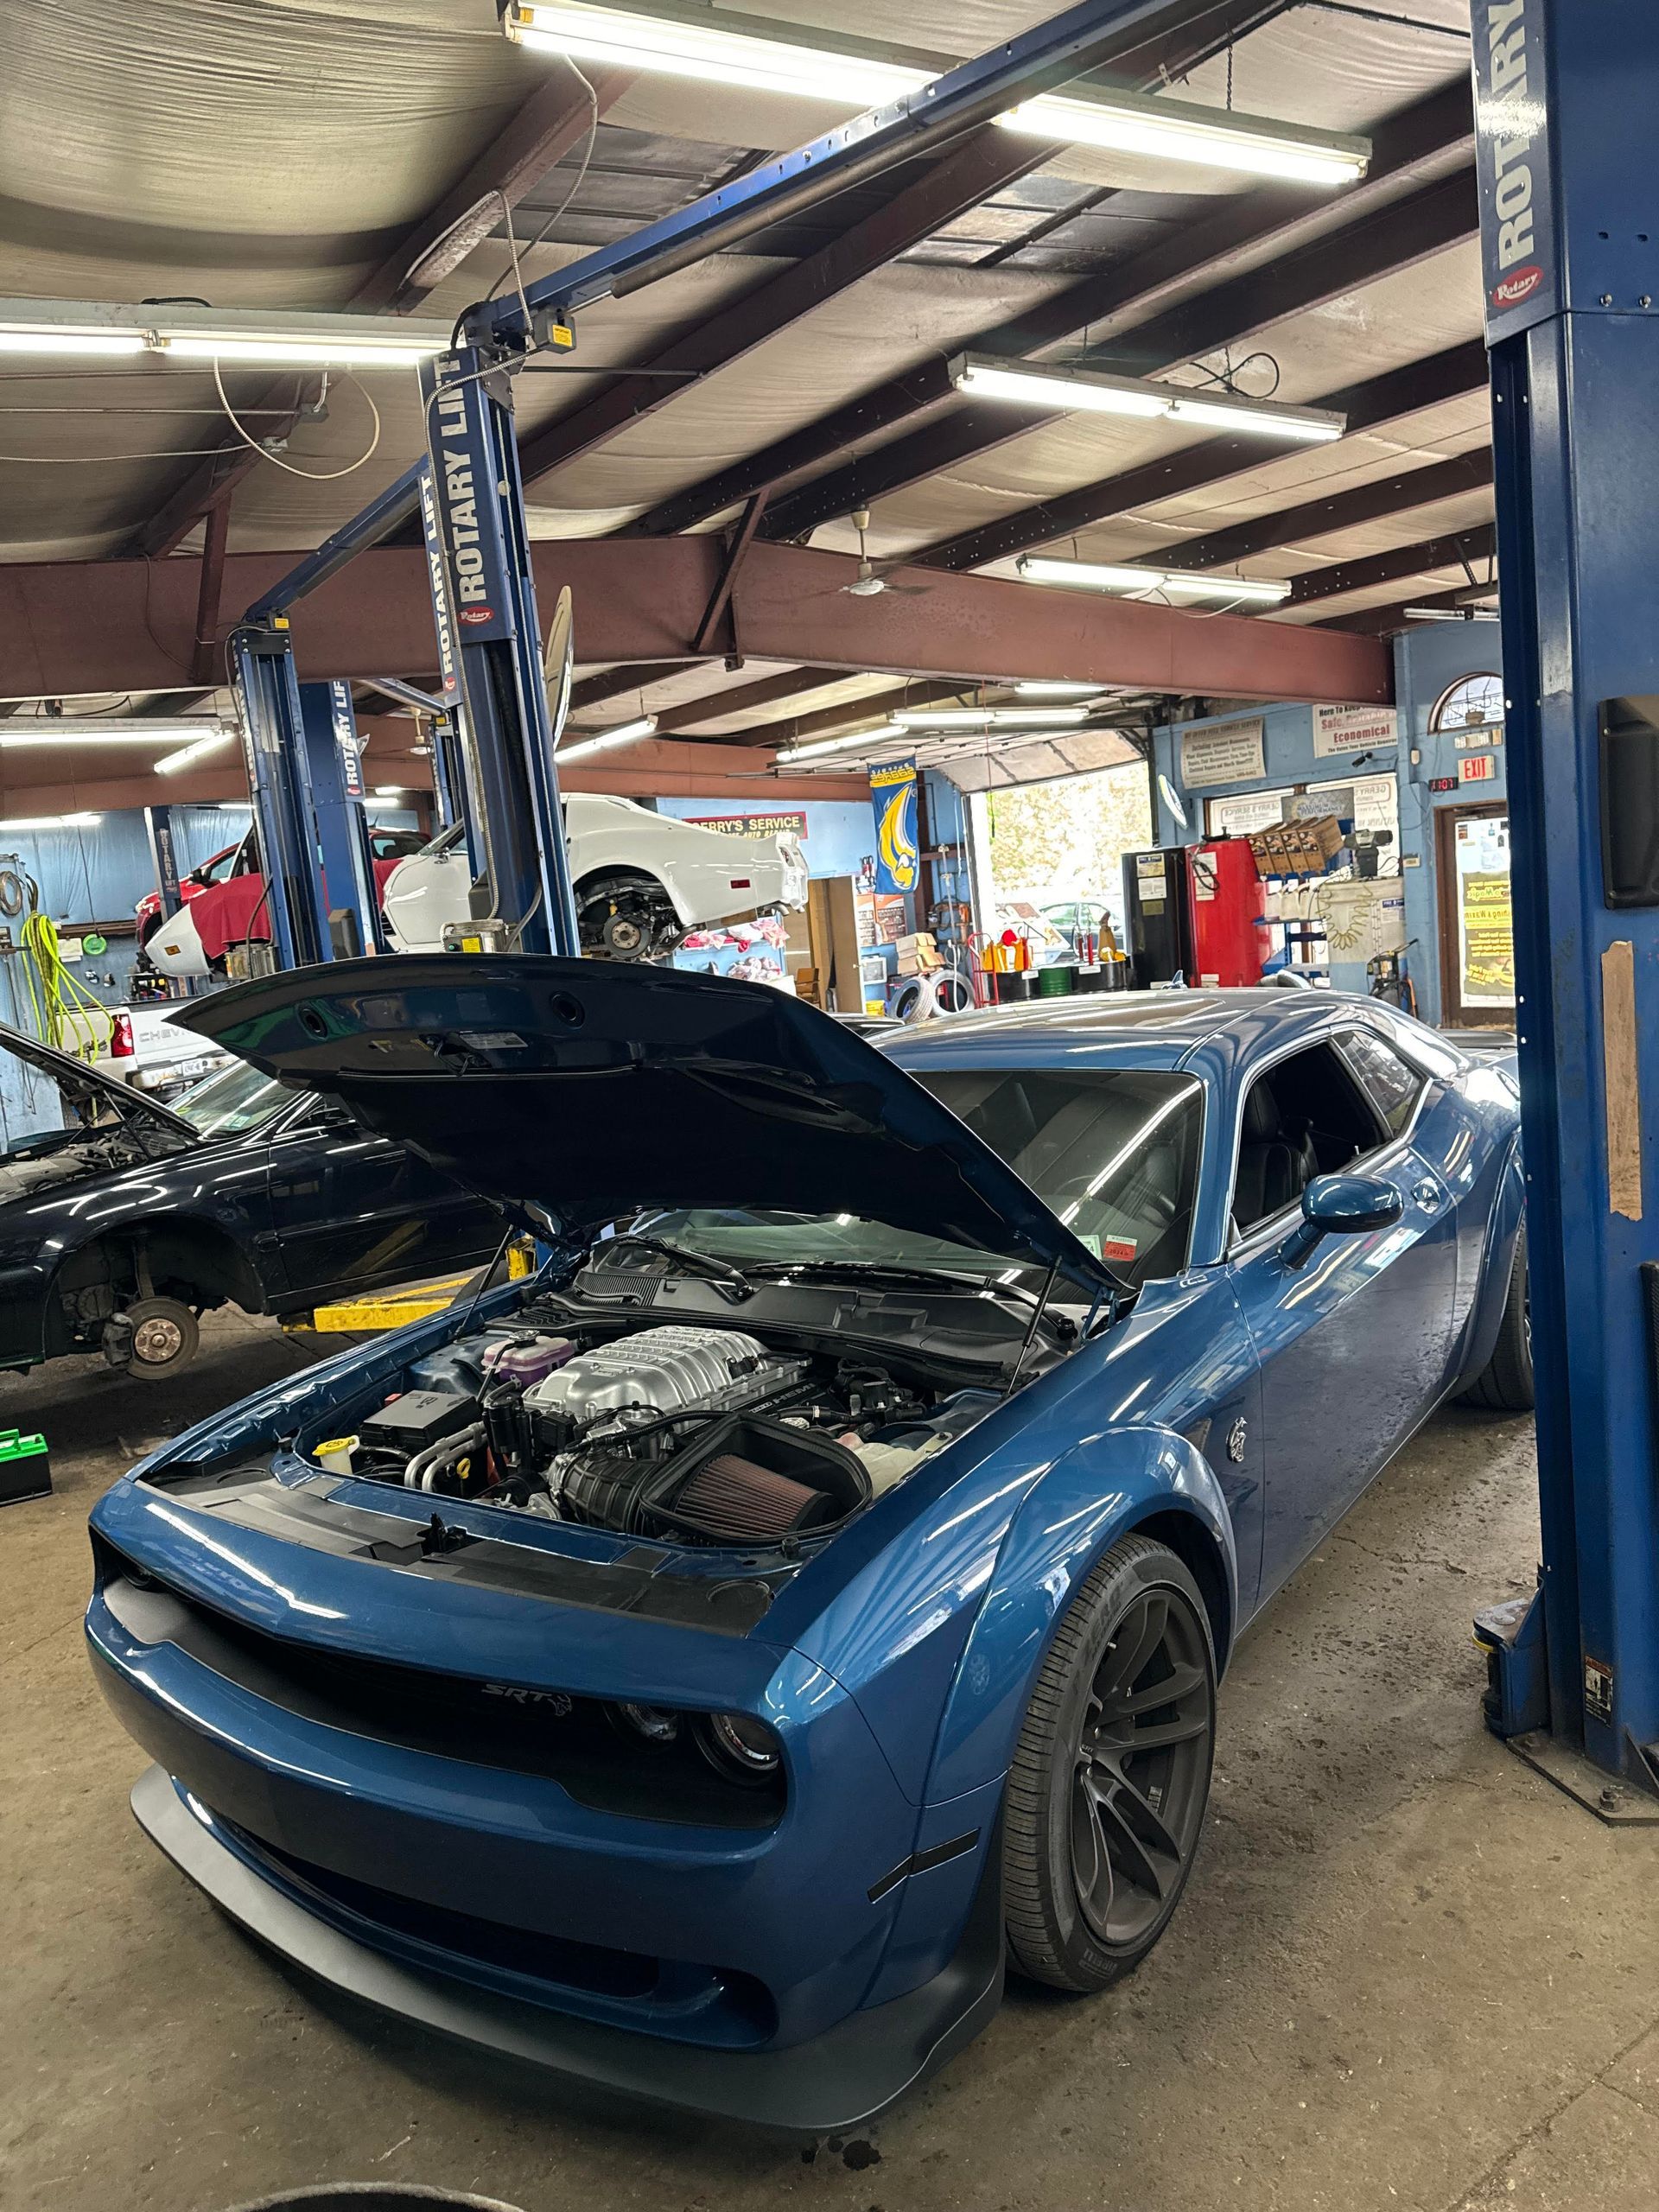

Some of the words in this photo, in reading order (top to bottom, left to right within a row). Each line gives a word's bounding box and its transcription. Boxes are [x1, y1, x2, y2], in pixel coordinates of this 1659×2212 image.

[1497, 273, 1538, 301] Rotary
[433, 357, 467, 436] LIFT
[422, 476, 438, 541] LIFT
[443, 449, 487, 603] ROTARY
[430, 550, 454, 675] ROTARY
[460, 612, 491, 622] Rotary
[1319, 708, 1334, 717] Here
[1335, 706, 1344, 715] To
[1333, 724, 1390, 743] Economical
[1465, 758, 1487, 779] EXIT
[749, 816, 800, 830] SERVICE
[139, 1027, 191, 1042] CHEV
[772, 1382, 816, 1404] HEMI
[481, 1683, 552, 1704] SRT
